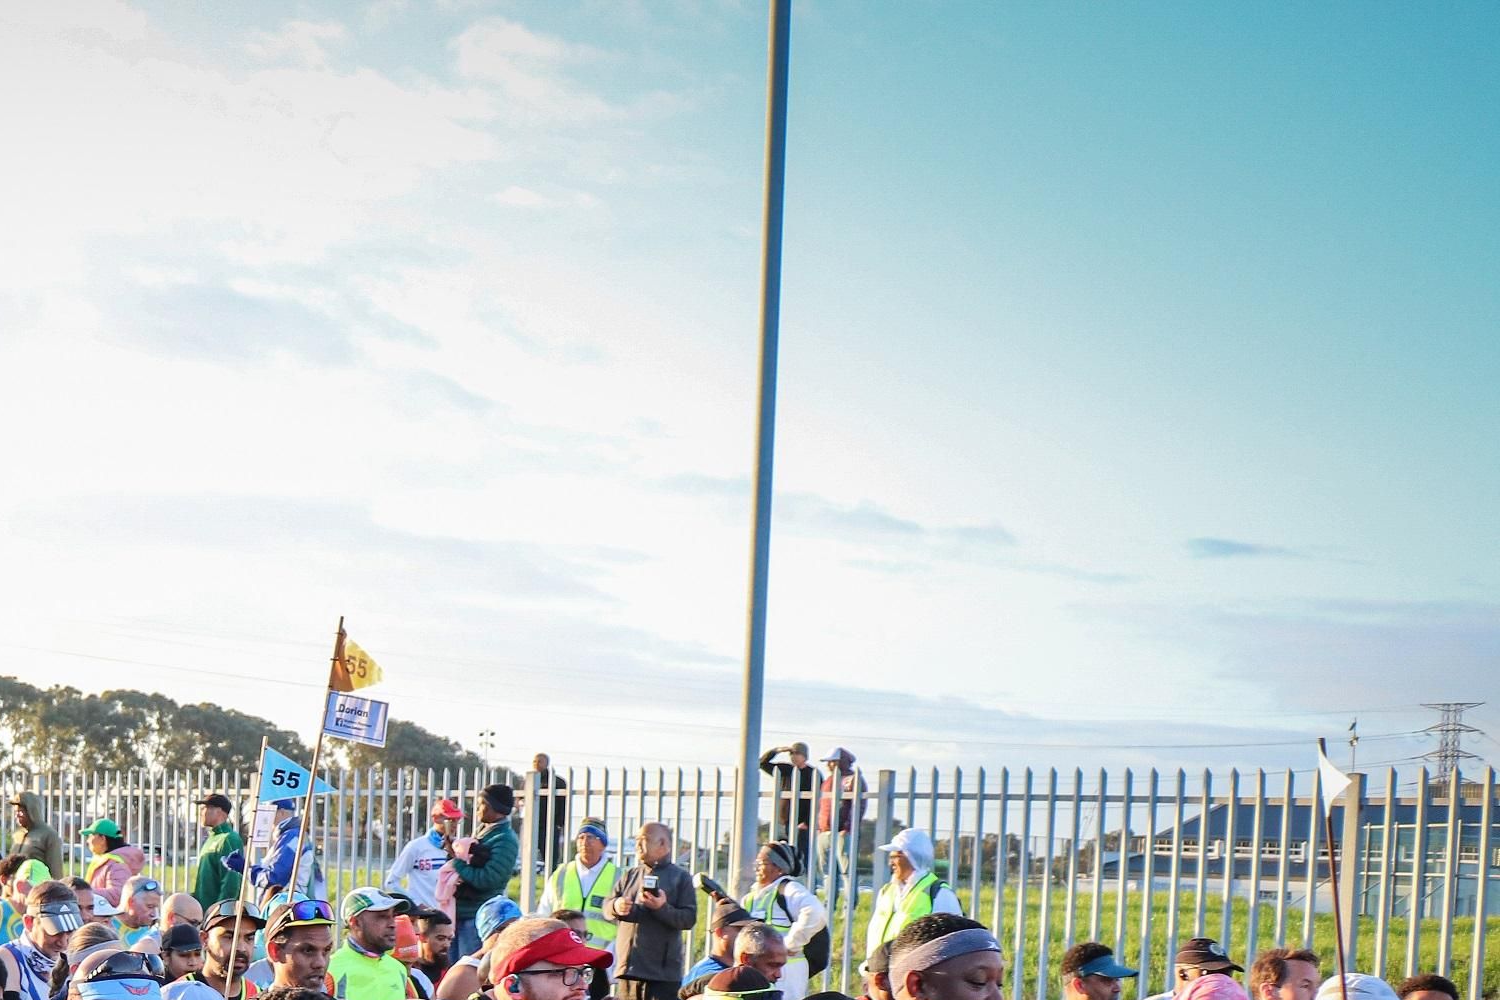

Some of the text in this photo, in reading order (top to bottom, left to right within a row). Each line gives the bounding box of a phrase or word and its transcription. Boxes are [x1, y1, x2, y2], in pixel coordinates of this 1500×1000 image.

[346, 655, 367, 679] 55
[339, 703, 369, 718] Dorian
[272, 769, 300, 789] 55
